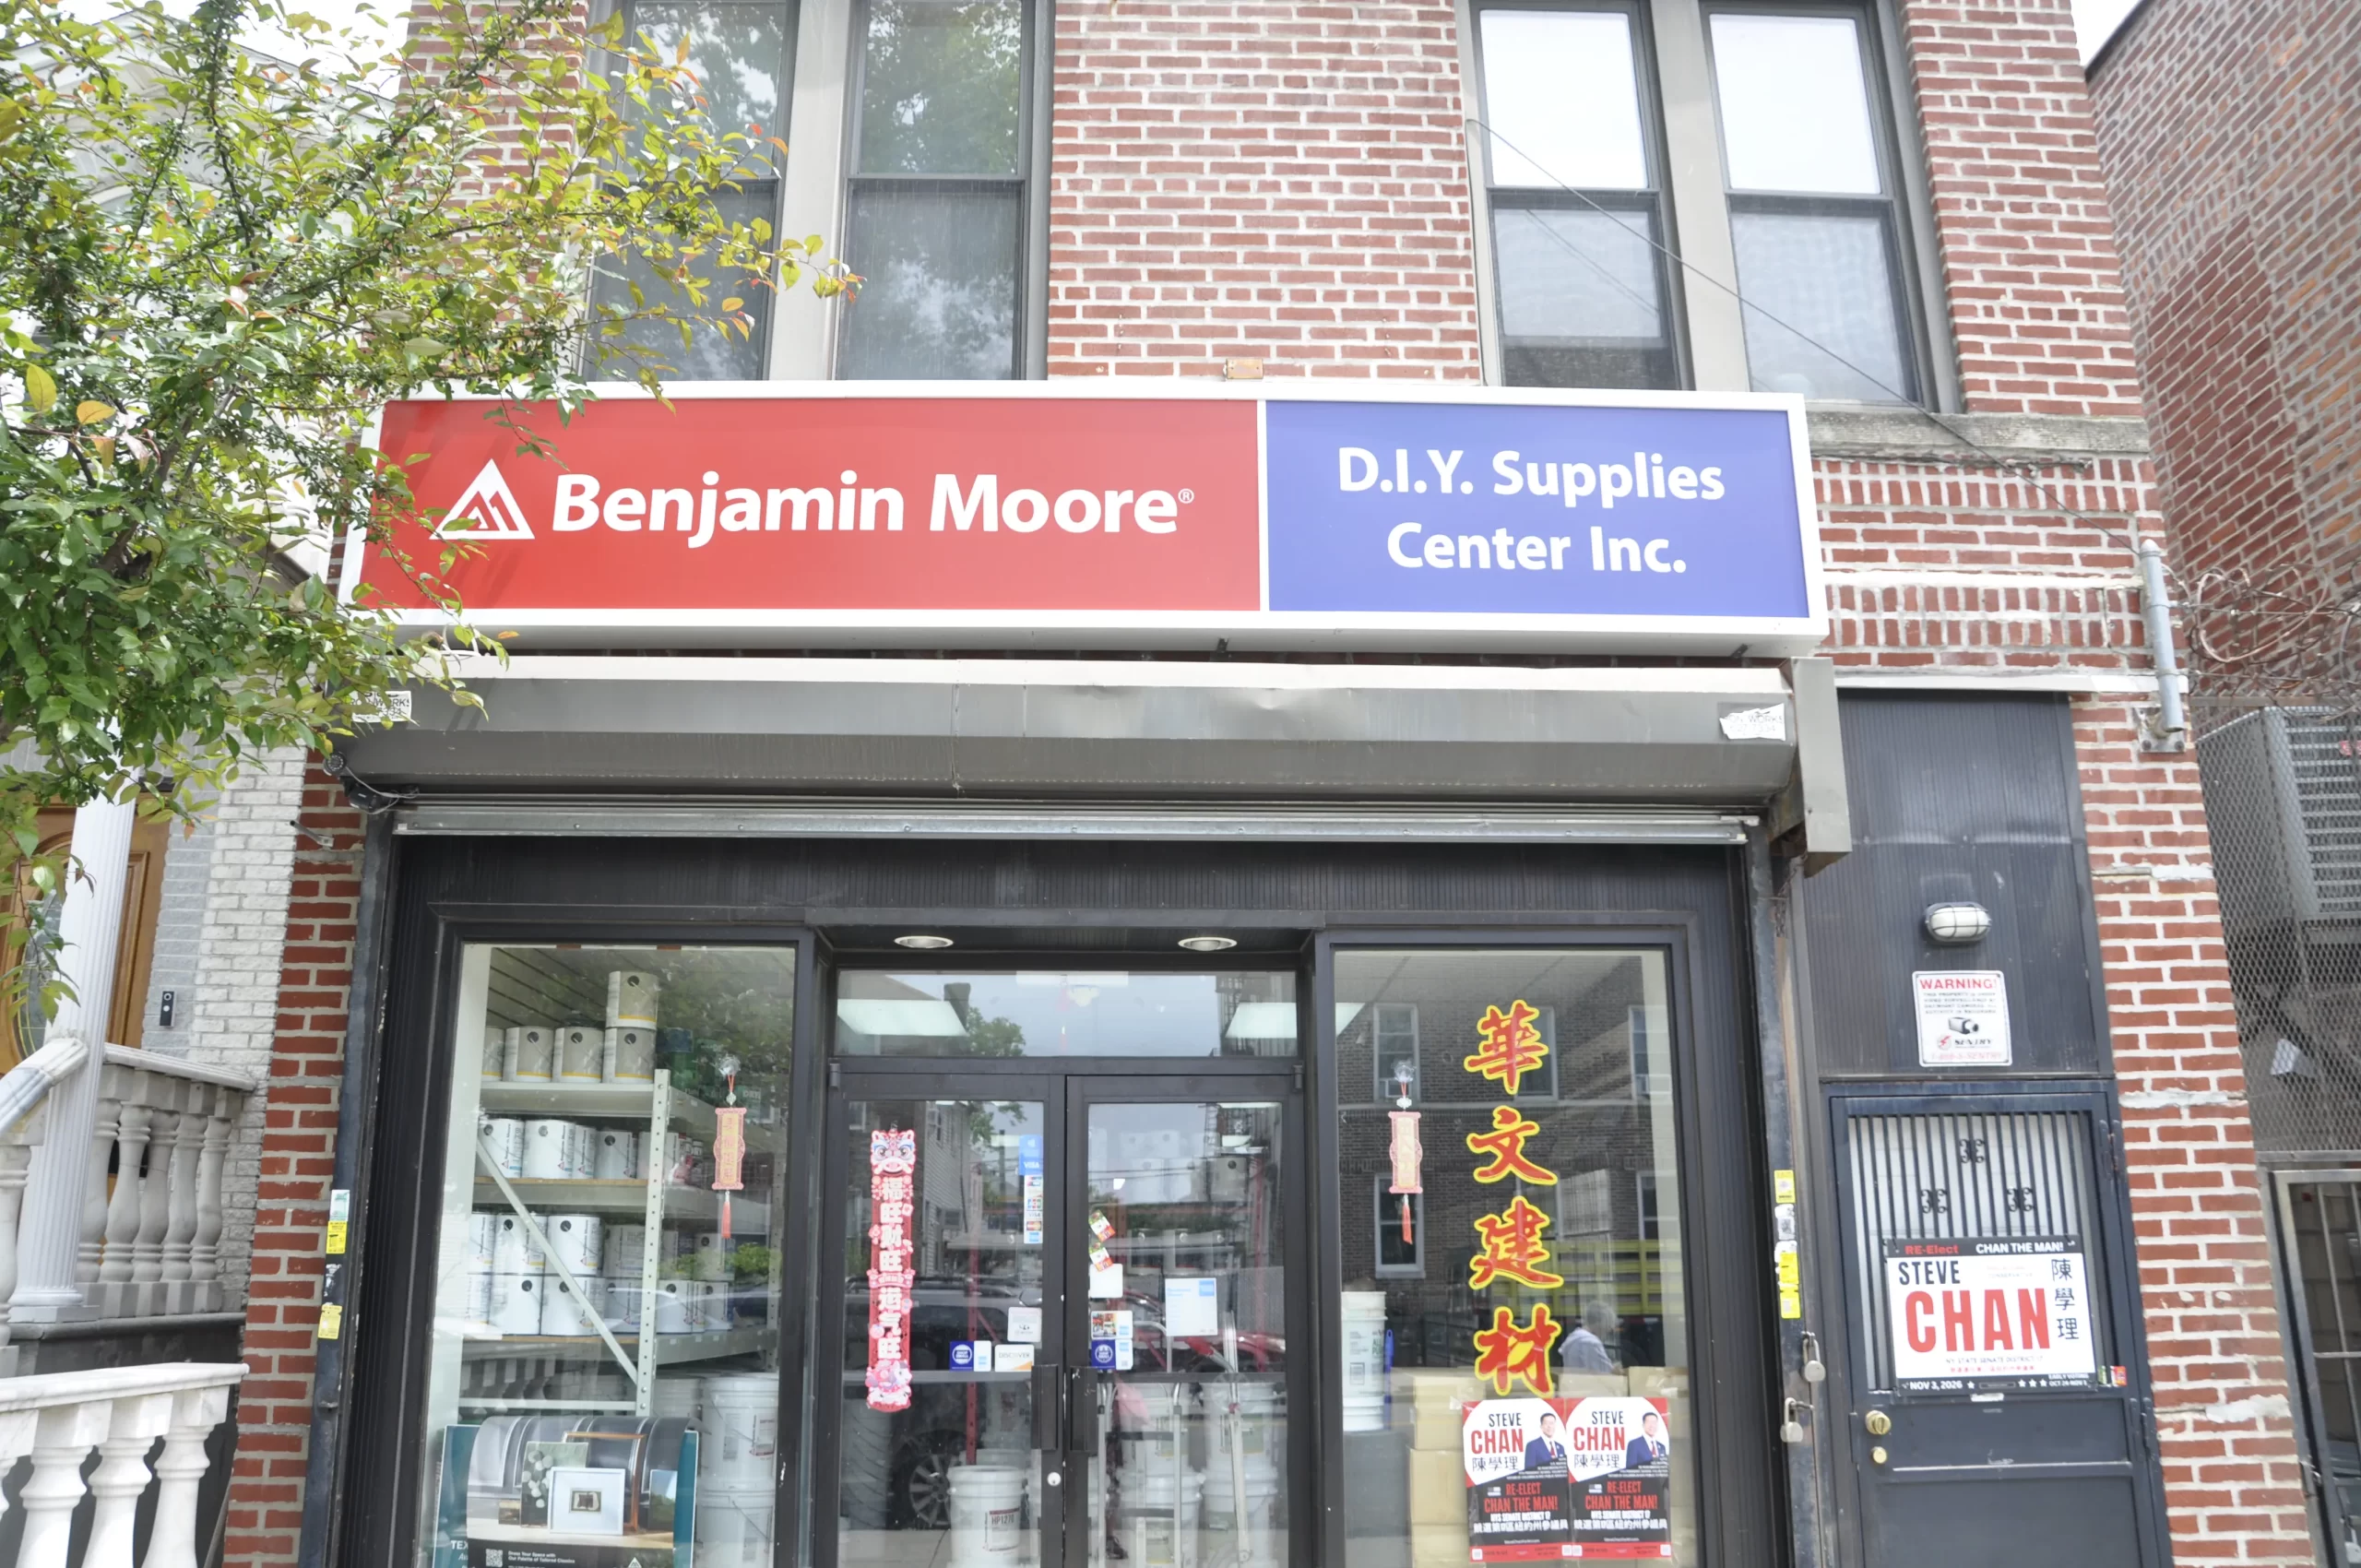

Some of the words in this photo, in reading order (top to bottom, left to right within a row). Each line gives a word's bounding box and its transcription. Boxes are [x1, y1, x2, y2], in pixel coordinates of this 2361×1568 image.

[1338, 446, 1474, 494] D.I.Y.
[1492, 450, 1726, 509] Supplies
[552, 469, 905, 549] Benjamin
[1387, 522, 1572, 571] Center
[1591, 526, 1687, 574] Inc.
[1919, 978, 1998, 990] WARNING!
[1464, 999, 1563, 1398] 華文建材
[1904, 1244, 1960, 1255] RE-Elect
[1975, 1242, 2010, 1254] CHAN
[2011, 1241, 2034, 1253] THE
[2035, 1241, 2065, 1253] MAN!
[1898, 1260, 1961, 1286] STEVE
[2050, 1258, 2080, 1341] 陳學理
[1904, 1288, 2051, 1353] CHAN
[1909, 1381, 1930, 1390] NOV
[1931, 1380, 1940, 1391] 3,
[1940, 1380, 1964, 1390] 2026
[1489, 1412, 1522, 1427] STEVE
[1591, 1410, 1624, 1425] STEVE
[1470, 1429, 1524, 1455] CHAN
[1573, 1427, 1625, 1451] CHAN
[1472, 1456, 1519, 1472] 陳學理
[1573, 1453, 1620, 1468] 陳學理
[1505, 1482, 1542, 1495] RE-ELECT
[1607, 1480, 1642, 1493] RE-ELECT
[1484, 1498, 1511, 1513] CHAN
[1513, 1497, 1531, 1512] THE
[1533, 1495, 1559, 1511] MAN!
[1584, 1495, 1611, 1510] CHAN
[1614, 1494, 1631, 1509] THE
[1633, 1494, 1658, 1509] MAN!
